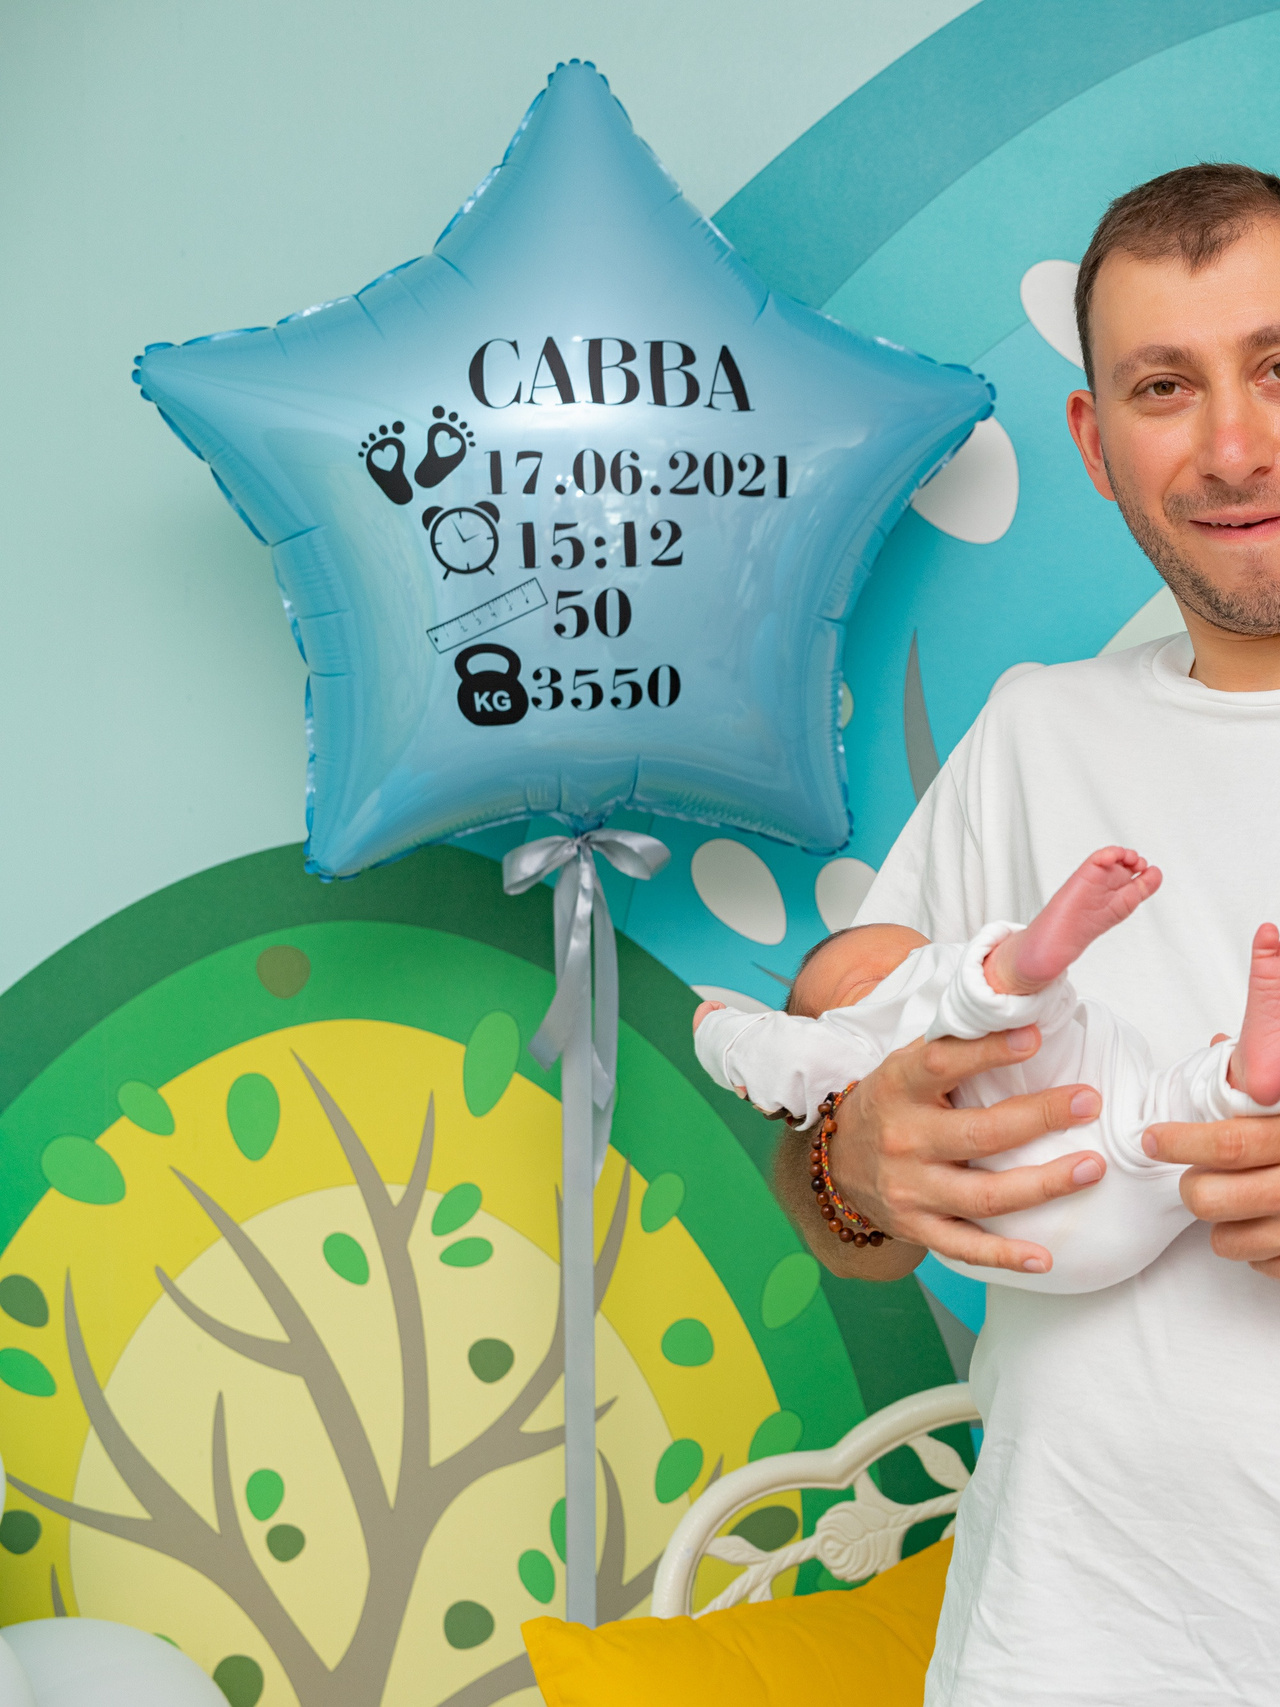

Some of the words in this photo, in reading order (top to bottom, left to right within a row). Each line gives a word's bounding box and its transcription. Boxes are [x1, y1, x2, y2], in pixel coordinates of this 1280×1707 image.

[484, 448, 792, 499] 17.06.2021
[515, 519, 685, 570] 15:12
[553, 586, 633, 640] 50
[473, 690, 512, 712] KG
[531, 664, 682, 712] 3550
